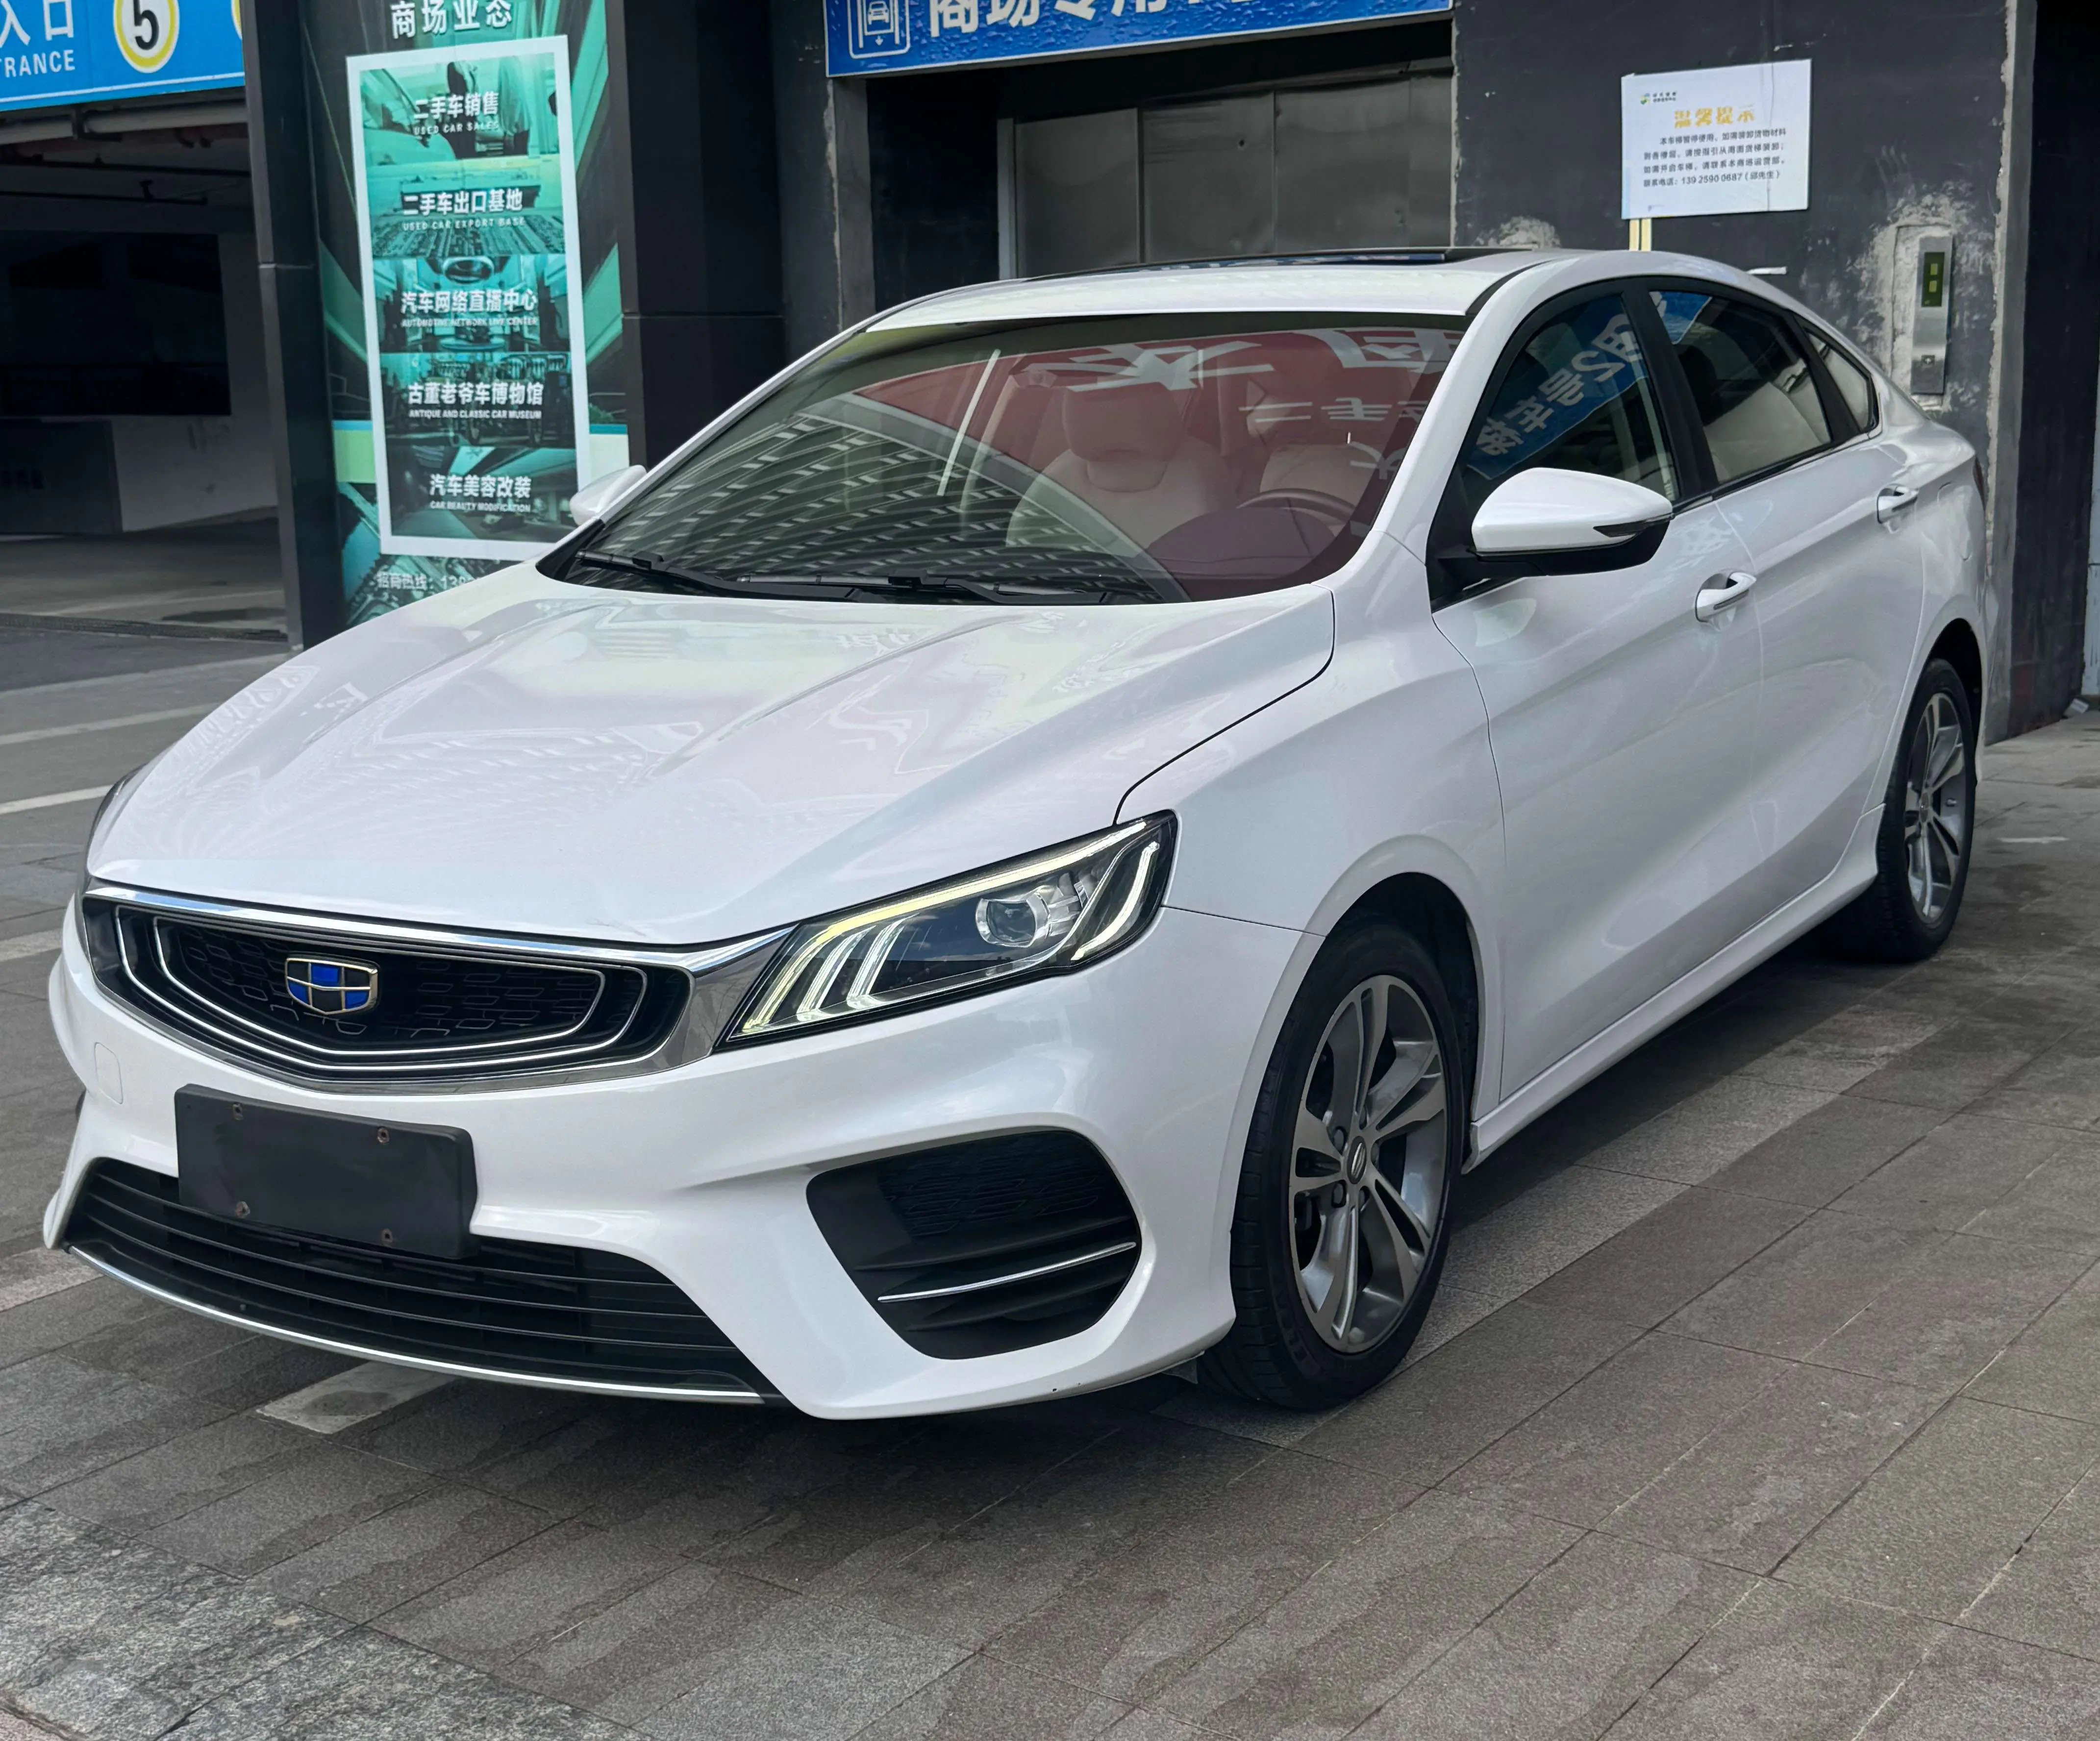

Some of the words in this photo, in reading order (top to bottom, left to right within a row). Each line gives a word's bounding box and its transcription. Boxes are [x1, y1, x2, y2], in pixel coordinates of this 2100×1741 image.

[132, 0, 159, 50] 5
[391, 0, 512, 39] 商场业态
[0, 50, 75, 78] RANCE
[414, 91, 499, 119] 二手车销售
[1674, 105, 1755, 128] 温馨提示
[413, 125, 439, 136] USED
[442, 124, 463, 133] CAR
[466, 121, 499, 131] SALES
[402, 188, 523, 216] 二手车出口基地
[431, 220, 451, 230] CAR
[400, 288, 538, 314] 汽车网络直播中心
[408, 381, 544, 405] 古董老爷车博物馆
[409, 409, 441, 420] ANTIQUE
[442, 410, 458, 418] AND
[459, 409, 490, 419] CLASSIC
[491, 409, 507, 419] CAR
[508, 410, 542, 419] MUSEUM
[429, 473, 531, 498] 汽车美容改装
[429, 500, 445, 509] CAR
